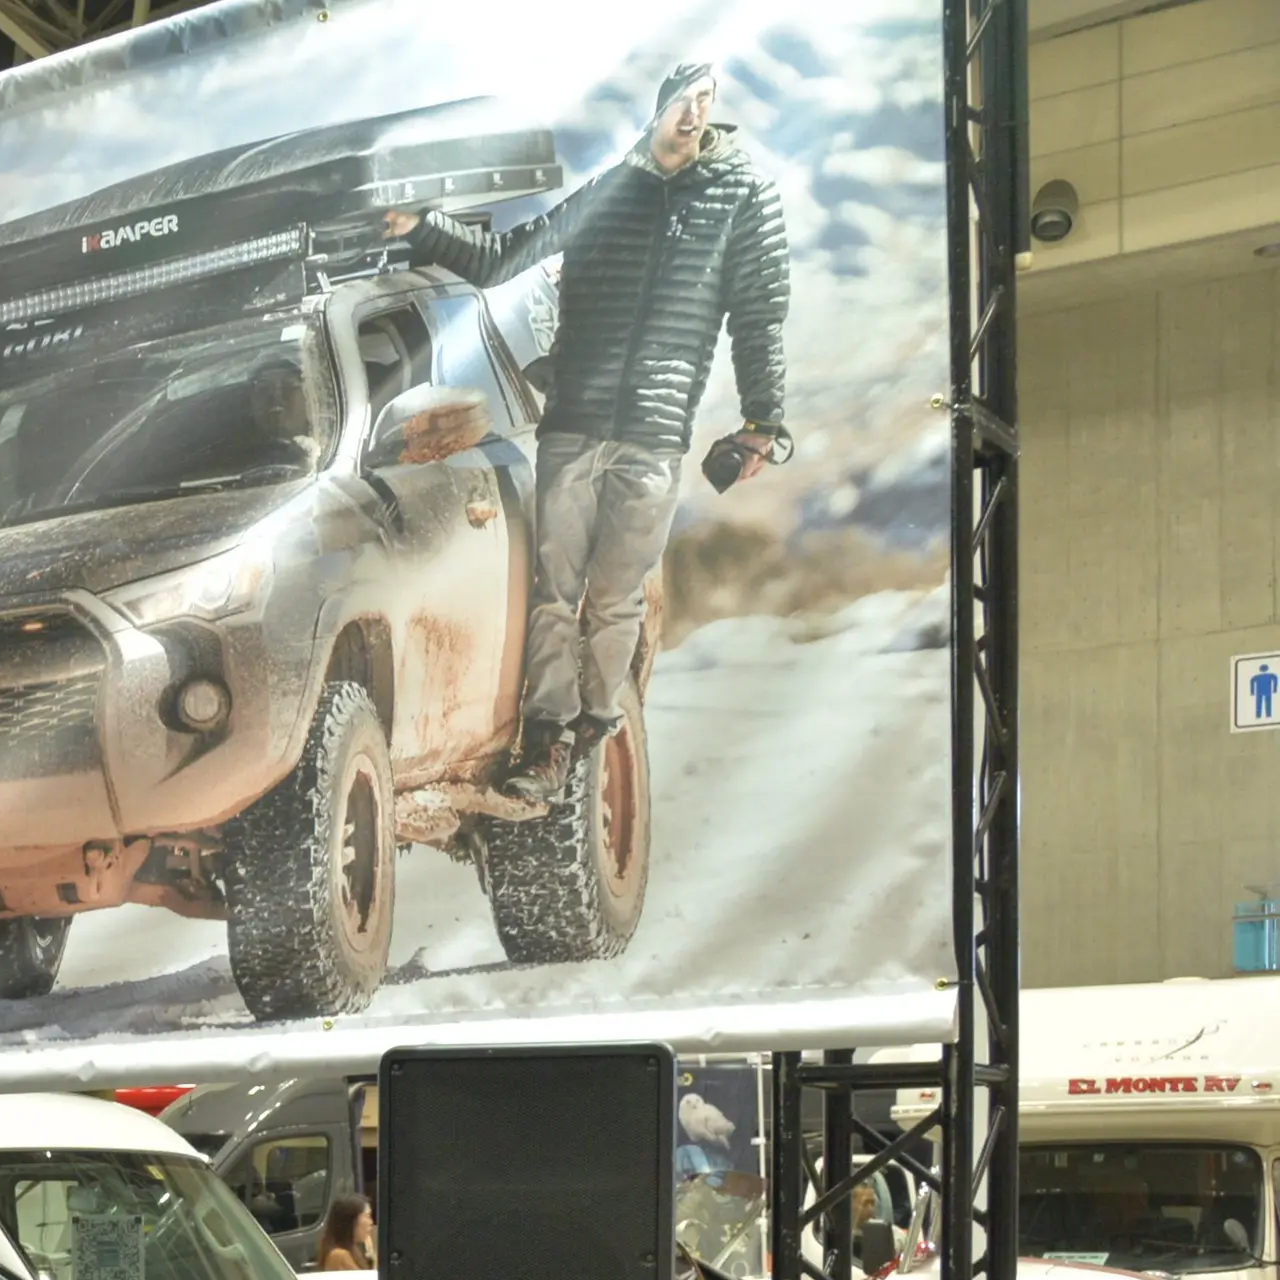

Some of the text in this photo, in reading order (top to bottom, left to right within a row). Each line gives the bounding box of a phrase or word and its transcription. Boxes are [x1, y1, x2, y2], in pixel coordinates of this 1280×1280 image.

[1068, 1075, 1242, 1095] EL MONTE RV
